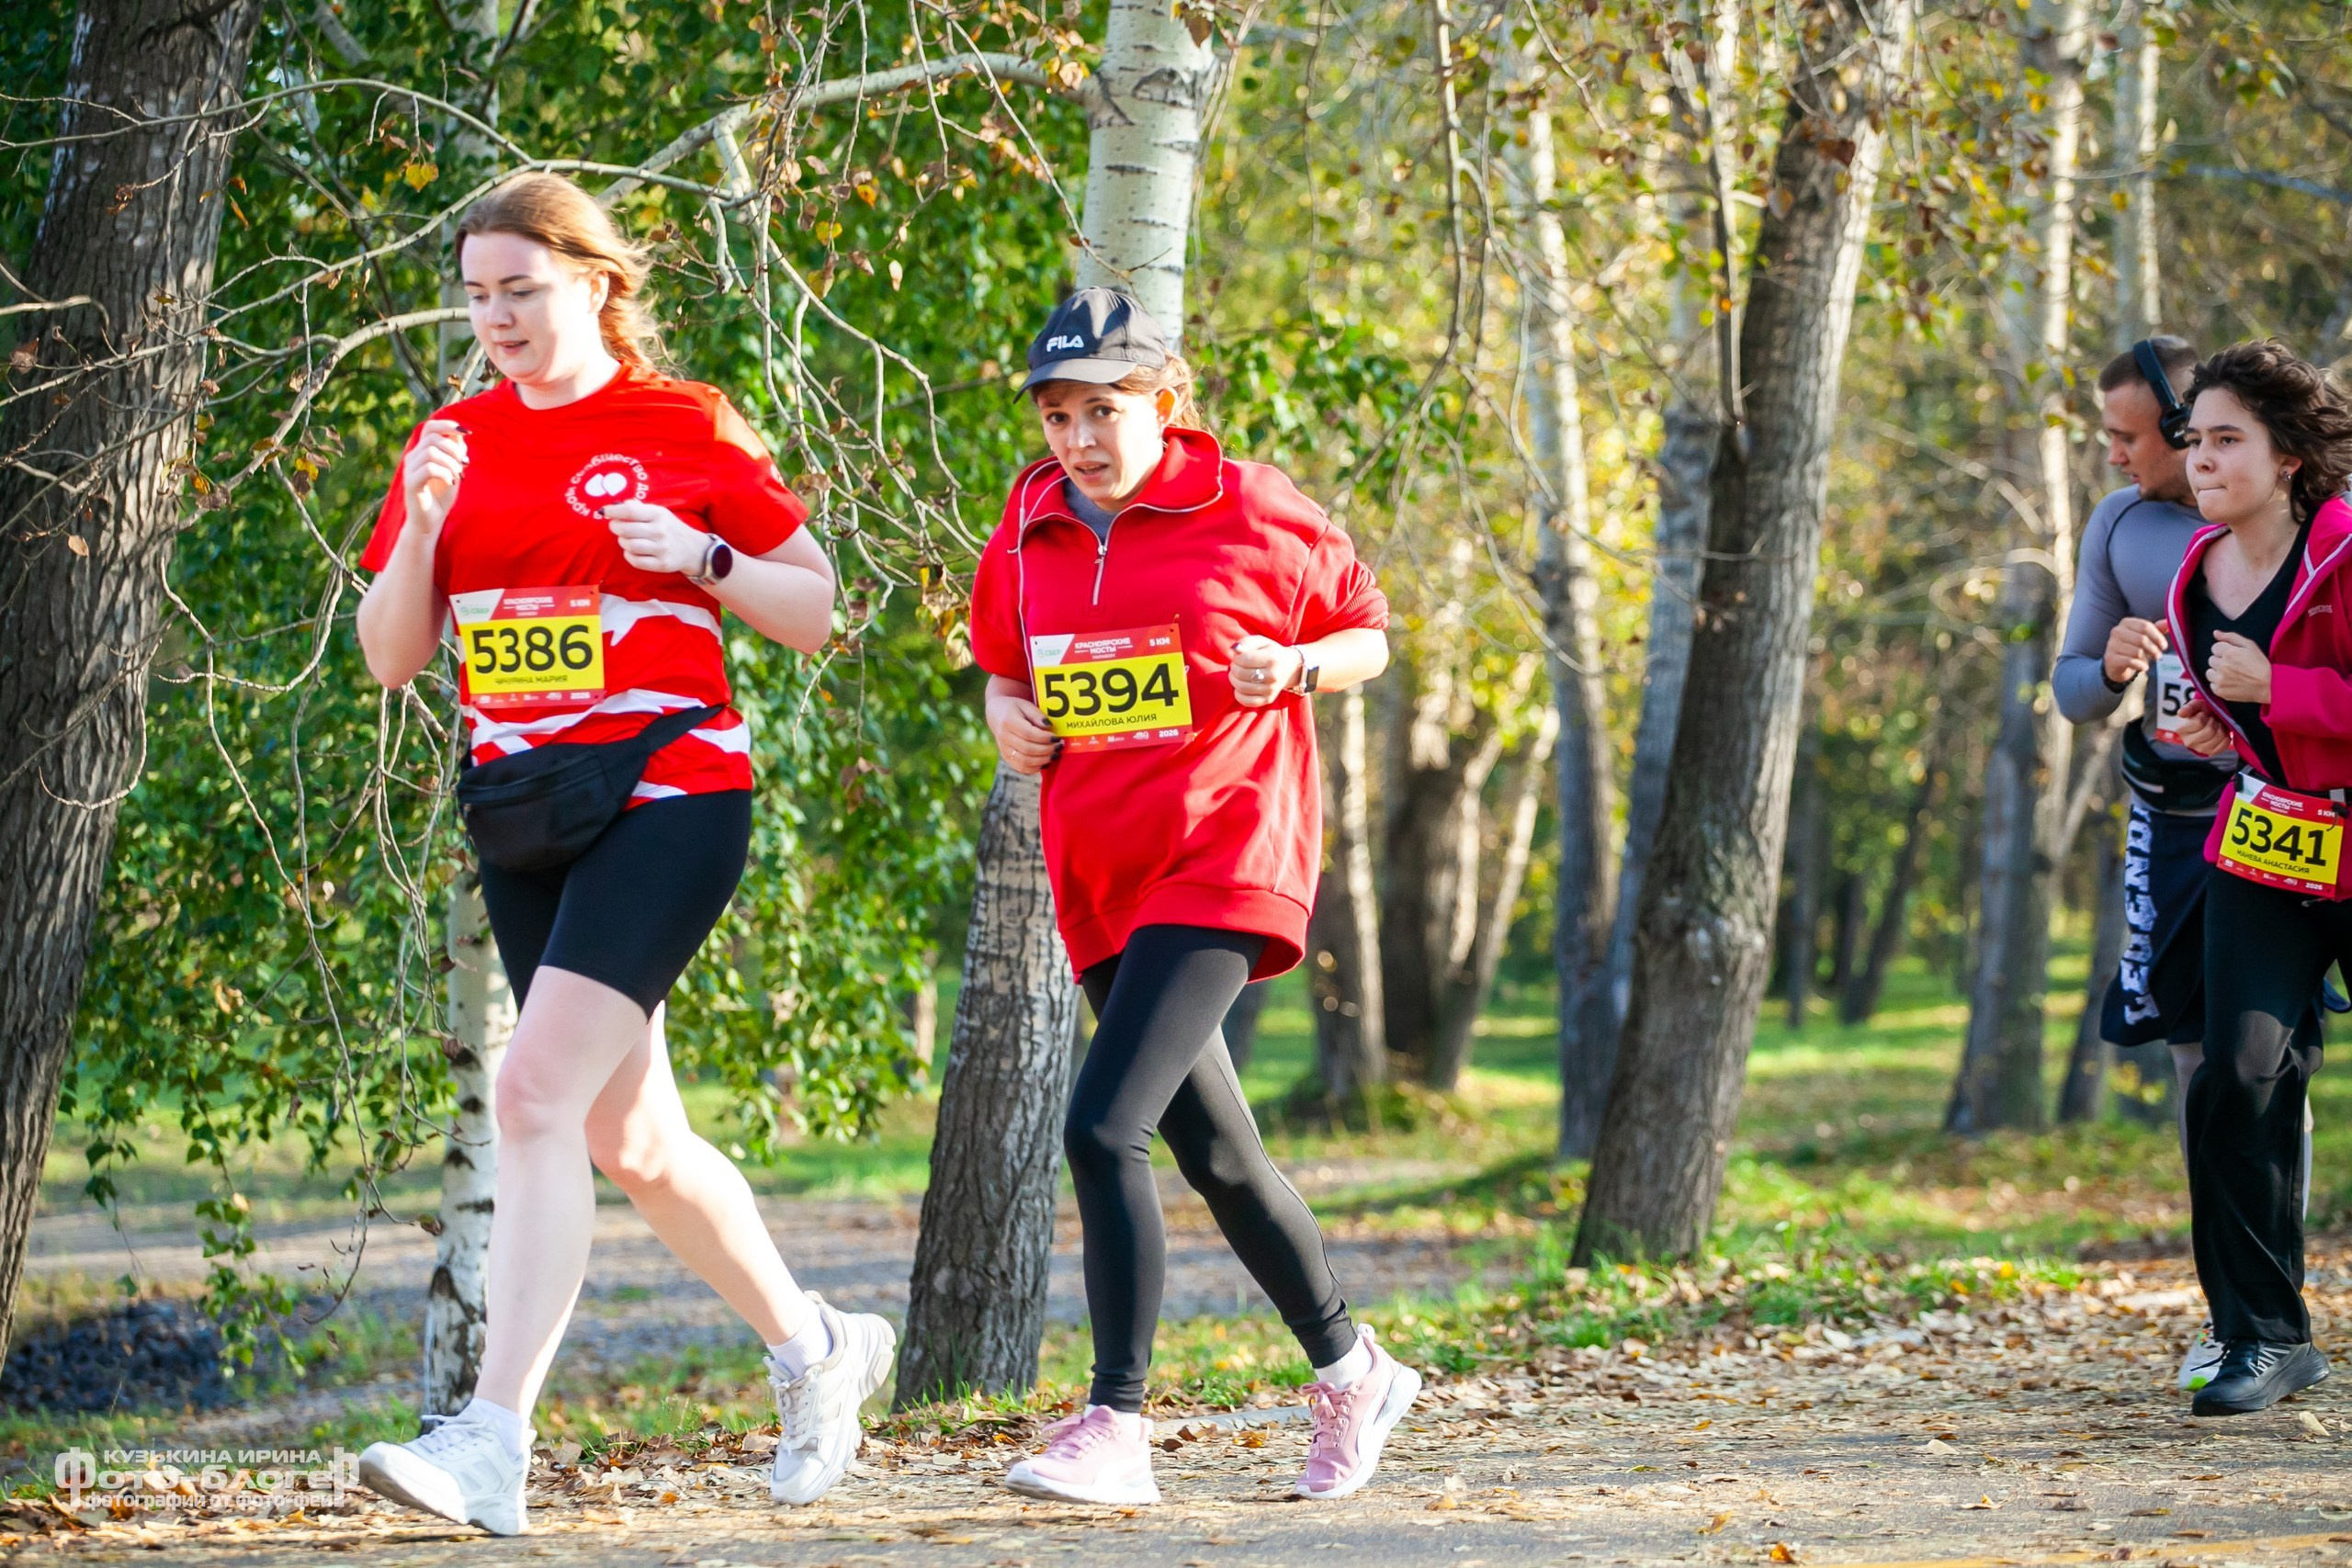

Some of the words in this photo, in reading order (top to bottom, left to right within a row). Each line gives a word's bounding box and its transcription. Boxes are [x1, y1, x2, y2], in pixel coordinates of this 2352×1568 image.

[1046, 334, 1084, 353] FILA
[471, 624, 594, 674] 5386
[1075, 637, 1131, 649] КРАСНОЯРСКИЕ
[1157, 637, 1170, 646] КМ
[1090, 646, 1117, 655] МОСТЫ
[1044, 662, 1180, 718] 5394
[1066, 716, 1125, 729] МИХАЙЛОВА
[1126, 714, 1157, 724] ЮЛИЯ
[2231, 807, 2326, 866] 5341
[2263, 859, 2310, 874] АНАСТАСИЯ
